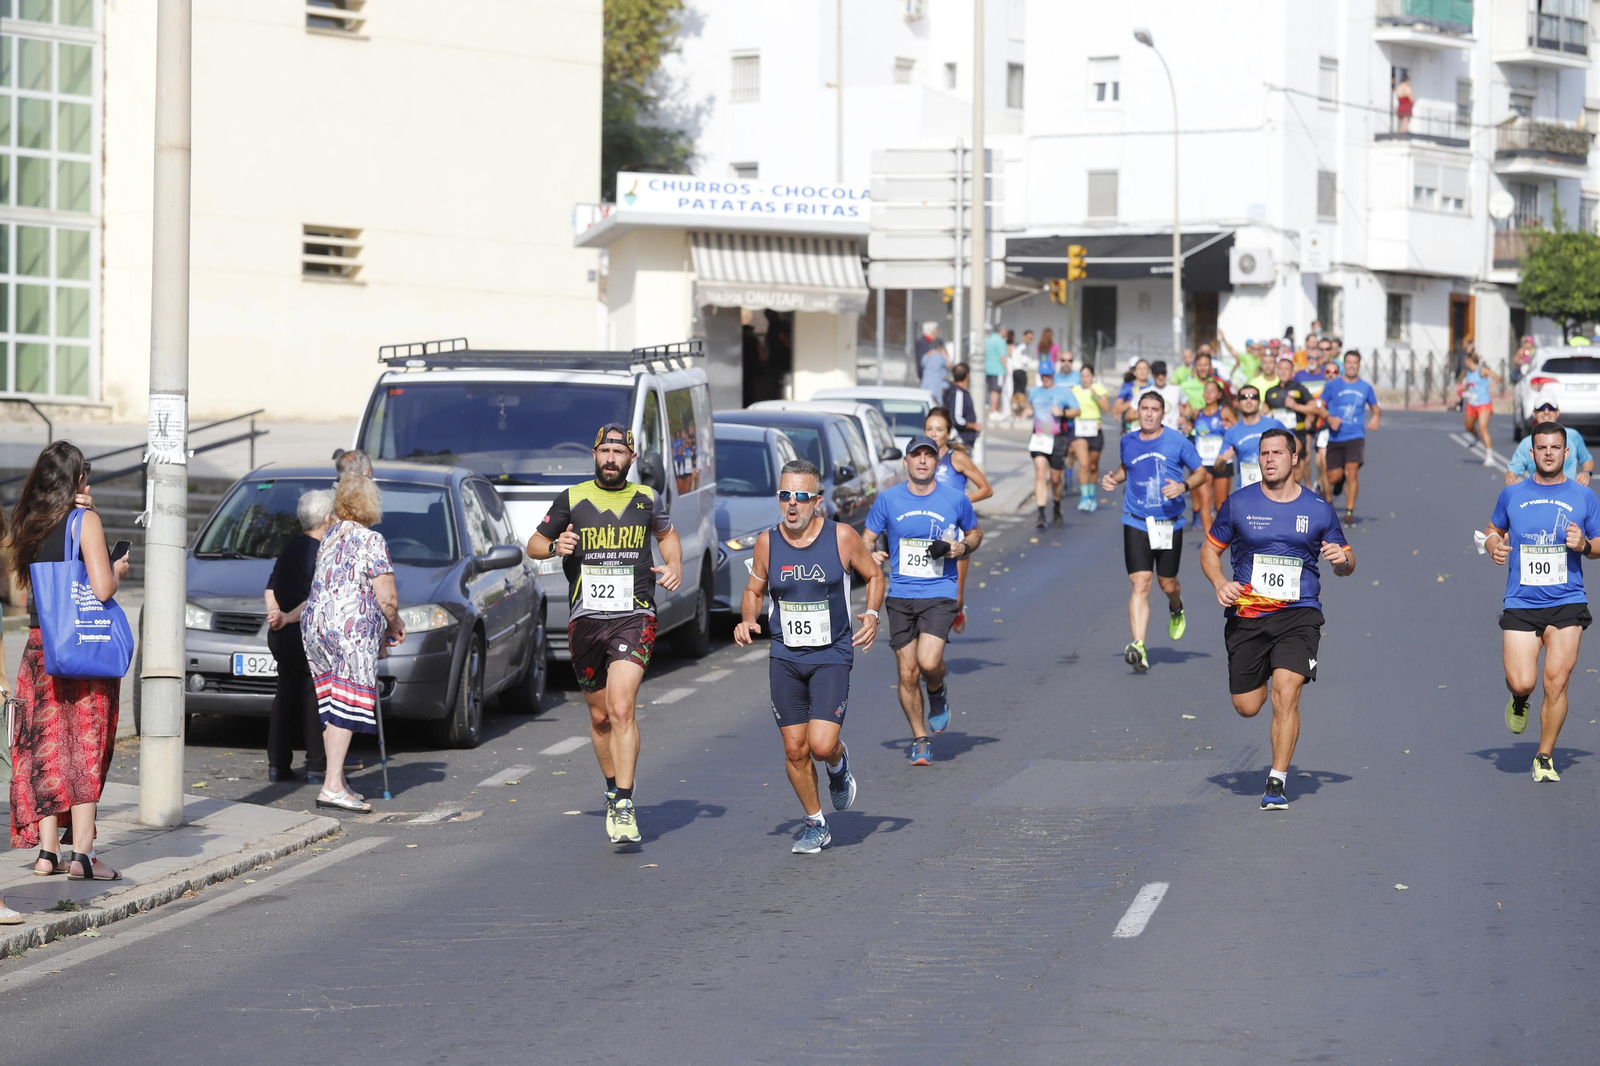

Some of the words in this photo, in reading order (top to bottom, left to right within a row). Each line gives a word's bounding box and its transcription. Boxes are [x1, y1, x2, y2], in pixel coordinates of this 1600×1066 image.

[648, 179, 752, 196] CHURROS
[677, 198, 777, 214] PATATAS
[783, 202, 859, 218] FRITAS
[1296, 518, 1309, 533] 091
[585, 552, 605, 560] LUCENA
[618, 551, 640, 559] PUERTO
[907, 553, 929, 567] 295
[1263, 556, 1279, 564] VUELTA
[1284, 558, 1300, 566] HUELVA
[781, 563, 826, 582] FILA
[1528, 561, 1551, 575] 190
[1261, 572, 1285, 587] 186
[590, 583, 616, 599] 322
[807, 603, 826, 611] HUELVA
[787, 620, 812, 635] 185
[247, 657, 278, 674] 924
